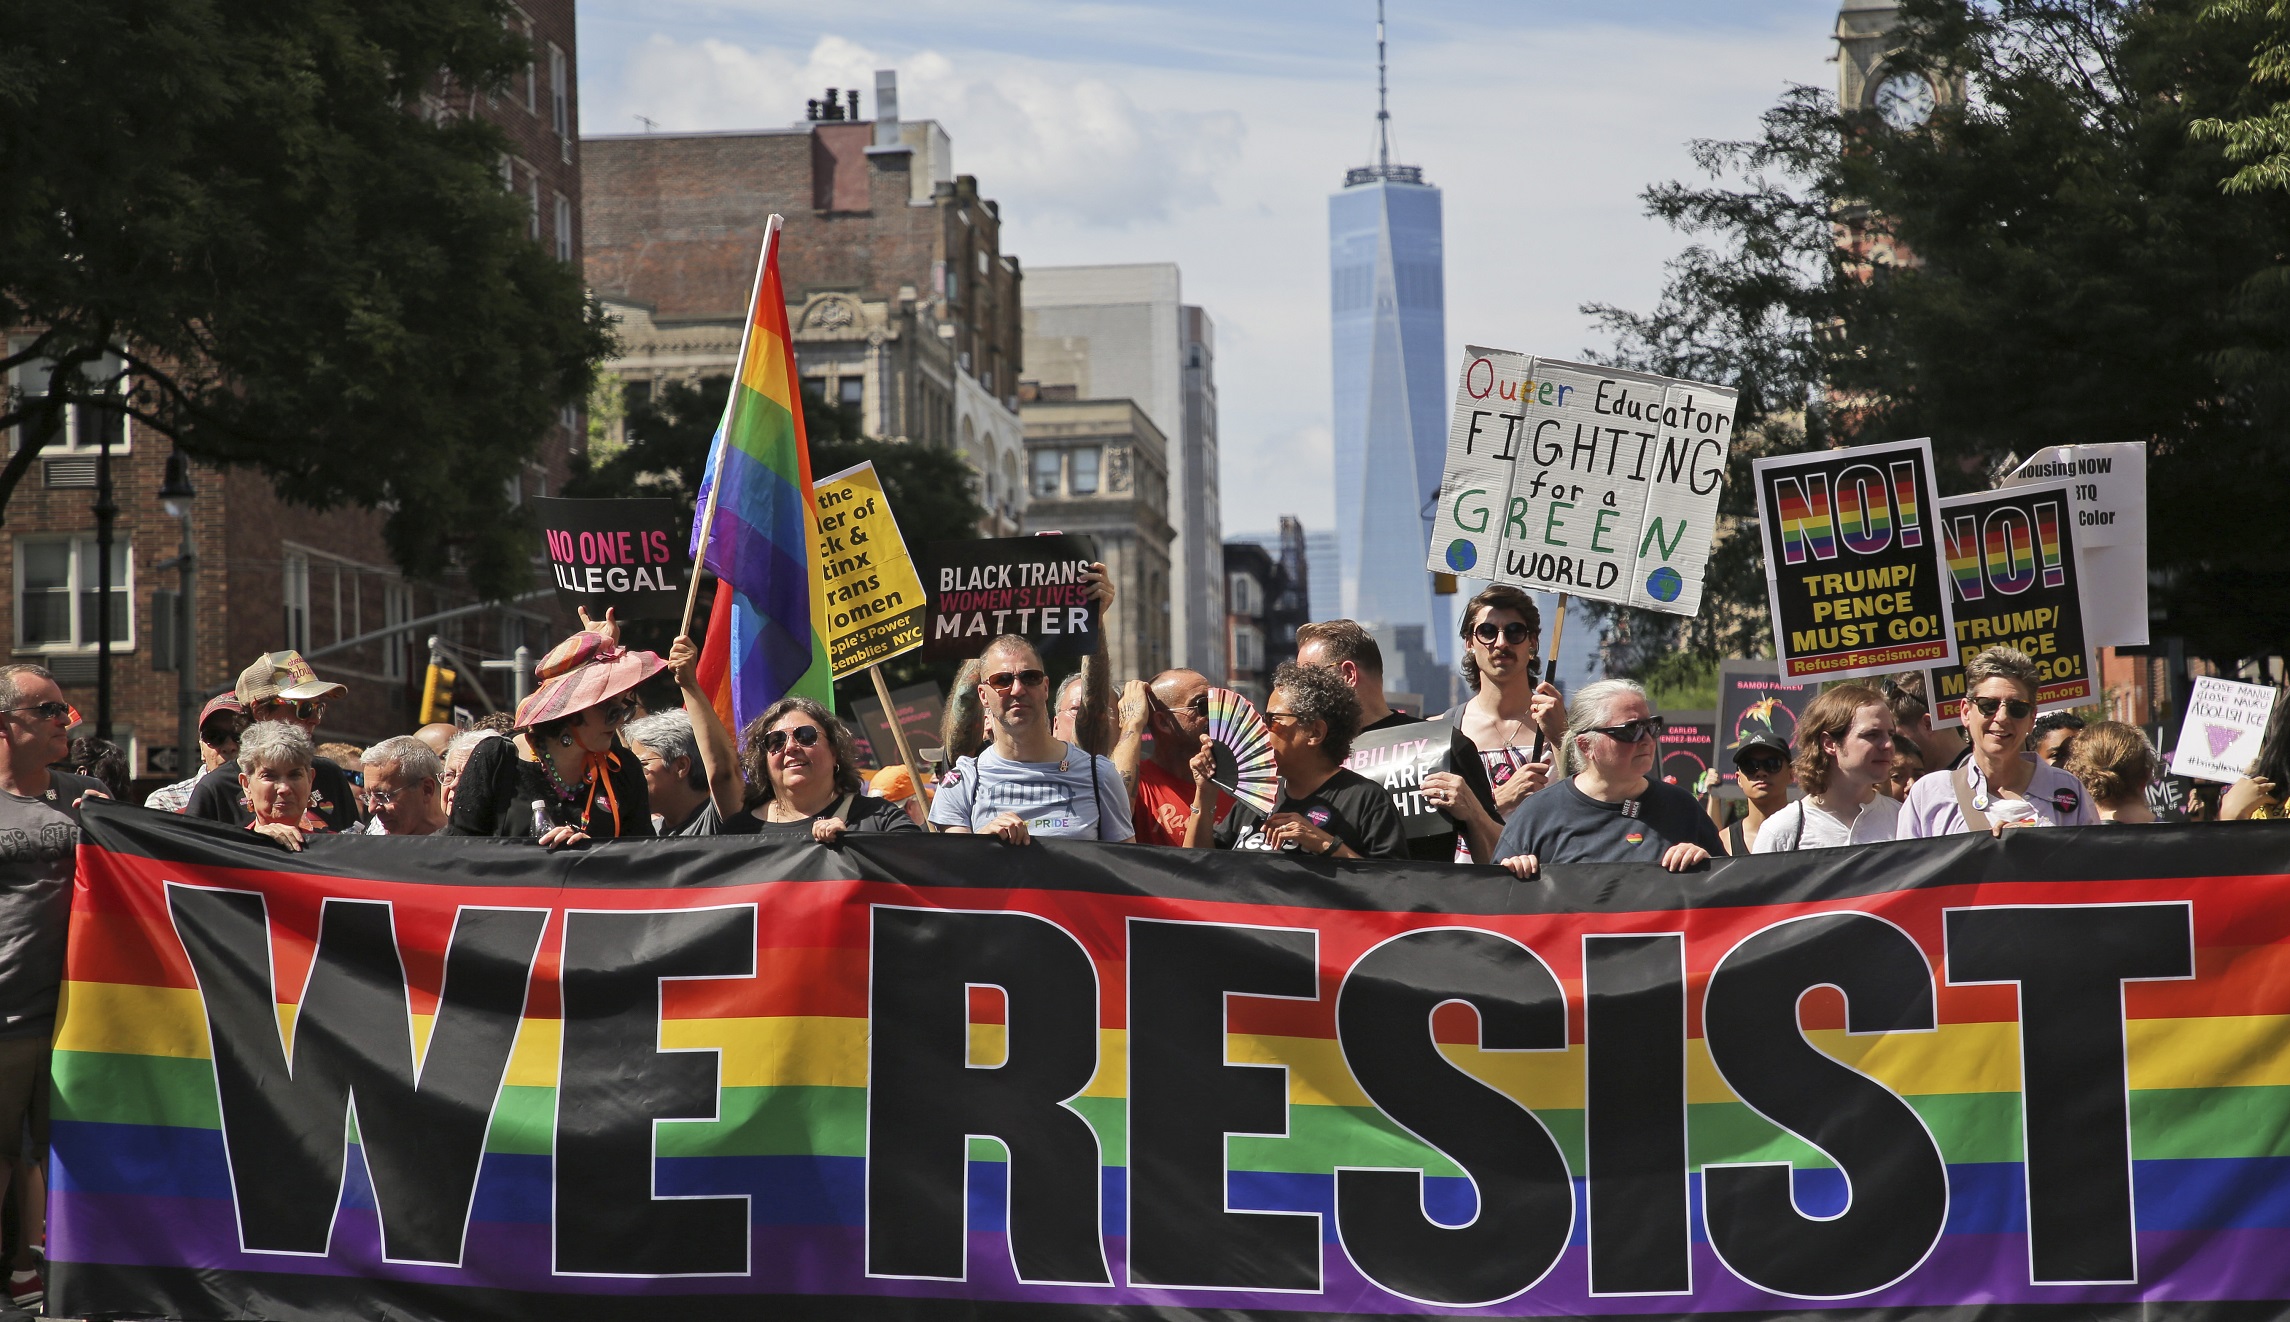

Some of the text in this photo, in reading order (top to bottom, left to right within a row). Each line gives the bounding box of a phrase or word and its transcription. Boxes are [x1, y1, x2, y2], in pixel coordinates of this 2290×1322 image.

[1467, 358, 1729, 434] Queer Educator
[1467, 411, 1725, 495] FIGHTING
[2078, 457, 2112, 475] NOW
[818, 487, 853, 509] the
[1530, 471, 1616, 507] for a
[853, 497, 876, 520] of
[1773, 459, 1922, 565] NO!
[2079, 510, 2115, 526] Color
[850, 525, 870, 546] &
[1454, 489, 1687, 561] GREEN
[546, 529, 670, 565] NO ONE IS
[1941, 501, 2065, 602] NO!
[553, 563, 677, 593] ILLEGAL
[823, 551, 871, 581] tinx
[940, 559, 1089, 592] BLACK TRANS
[1506, 550, 1618, 590] WORLD
[1802, 563, 1916, 597] TRUMP/
[829, 590, 904, 633] omen
[939, 585, 1088, 613] WOMEN'S LIVES
[1813, 591, 1913, 623] PENCE
[868, 614, 911, 640] Power
[892, 626, 922, 647] NYC
[935, 607, 1089, 640] MATTER
[1792, 614, 1938, 652] MUST GO!
[1954, 605, 2059, 641] TRUMP/
[1794, 645, 1941, 674] RefuseFascism.org
[2191, 701, 2267, 727] ABOLISH ICE
[1383, 762, 1429, 790] ARE
[1035, 819, 1069, 828] PRIDE
[163, 880, 2195, 1309] WE RESIST
